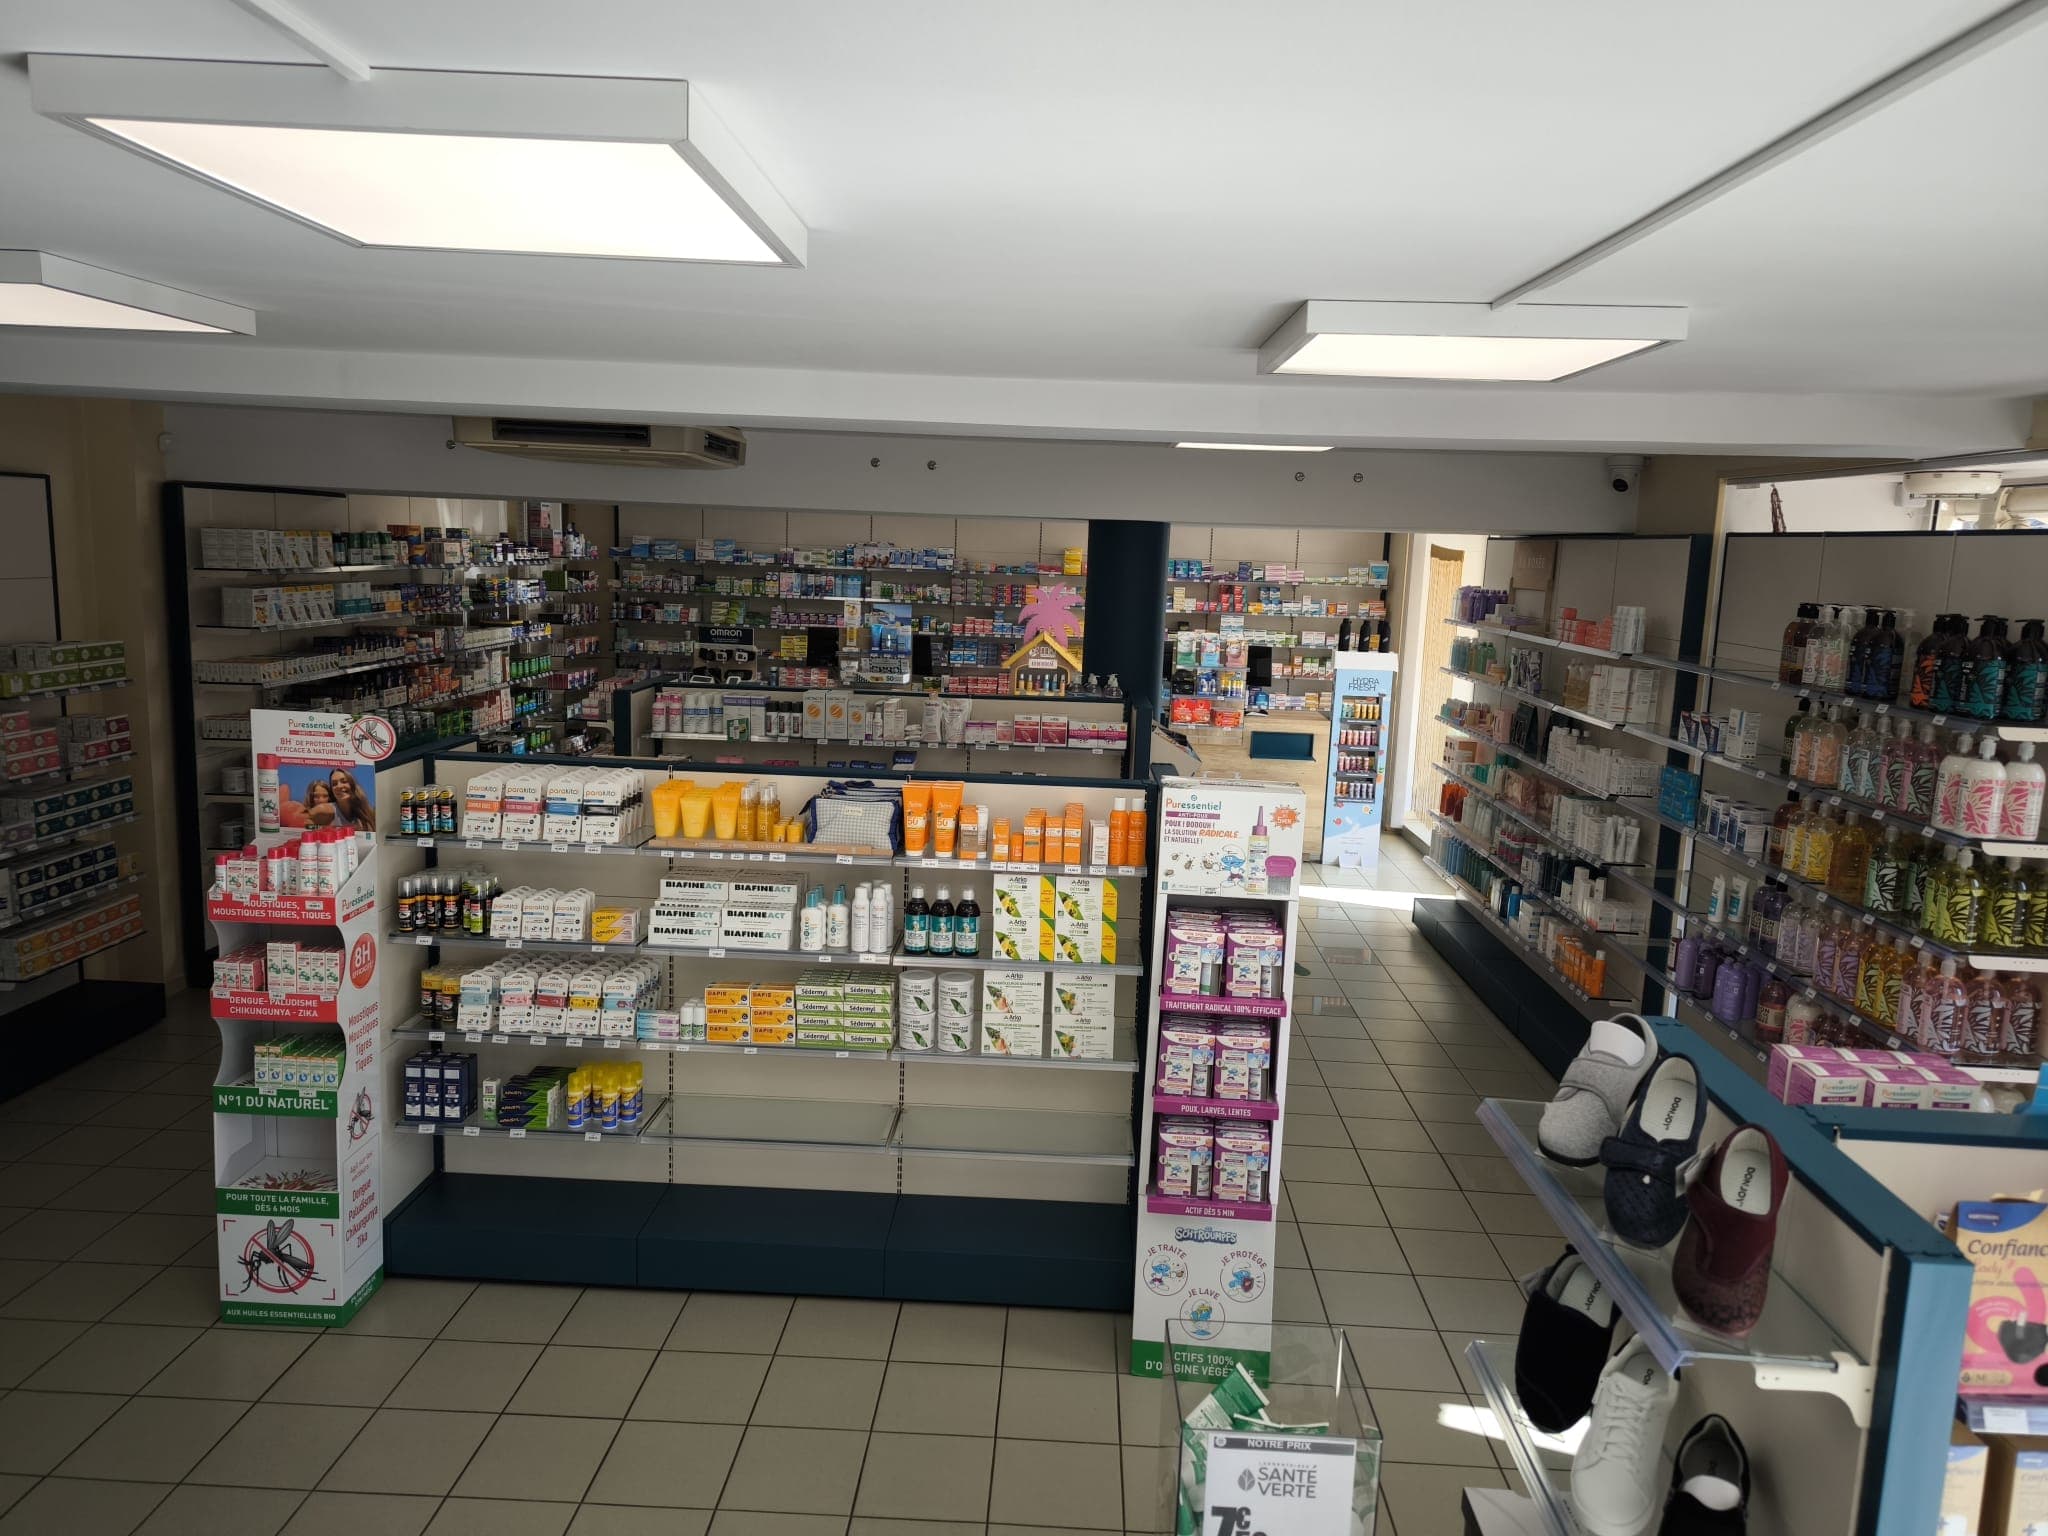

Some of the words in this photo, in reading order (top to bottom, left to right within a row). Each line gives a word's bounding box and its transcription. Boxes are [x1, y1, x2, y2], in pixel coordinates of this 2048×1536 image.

[1348, 683, 1376, 692] FRESH
[1352, 677, 1380, 686] HYDRA
[288, 718, 335, 730] Puressentiel
[275, 746, 308, 754] EFFICACE
[313, 748, 350, 756] NATURELLE
[305, 741, 345, 749] PROTECTION
[1166, 798, 1222, 811] Puressentiel
[1171, 836, 1200, 844] NATURELLE
[1199, 829, 1239, 839] RADICALE
[341, 885, 375, 911] Puressentiel
[244, 900, 300, 910] MOUSTIQUES,
[213, 908, 266, 918] MOUSTIQUES
[267, 910, 300, 920] TIGRES,
[302, 911, 332, 920] TIQUES
[354, 942, 371, 968] 8H
[801, 987, 828, 997] Sédermyl
[850, 985, 877, 995] Sédermyl
[270, 997, 318, 1008] PALUDISME
[802, 1002, 829, 1012] Sédermyl
[849, 1004, 877, 1013] Sédermyl
[1165, 1000, 1205, 1011] TRAITEMENT
[1205, 1003, 1232, 1013] RADICAL
[1233, 1005, 1252, 1014] 100%
[1253, 1006, 1281, 1016] EFFICACE
[230, 1006, 291, 1017] CHIKUNGUNYA
[298, 1008, 318, 1018] ZIKA
[348, 1003, 379, 1029] Moustiques
[802, 1017, 829, 1027] Sédermyl
[850, 1019, 877, 1029] Sédermyl
[348, 1020, 379, 1045] Moustiques
[803, 1031, 829, 1041] Sédermyl
[850, 1035, 877, 1045] Sédermyl
[356, 1038, 373, 1056] Tigres
[355, 1054, 374, 1073] Tiques
[218, 1094, 241, 1107] N°1
[246, 1096, 264, 1108] DU
[267, 1097, 329, 1110] NATUREL
[1181, 1105, 1200, 1115] POUX,
[1201, 1105, 1227, 1117] LARVES,
[1228, 1108, 1251, 1117] LENTES
[352, 1179, 371, 1202] Dengue
[226, 1192, 249, 1201] POUR
[250, 1193, 277, 1203] TOUTE
[278, 1195, 289, 1203] LA
[291, 1196, 329, 1206] FAMILLE,
[280, 1205, 300, 1213] MOIS
[348, 1192, 375, 1222] Paludisme
[1185, 1206, 1203, 1215] ACTIF
[1216, 1208, 1222, 1216] 5
[1222, 1209, 1235, 1218] MIN
[345, 1206, 378, 1242] Chikungunya
[357, 1231, 368, 1248] Zika
[1175, 1227, 1237, 1244] SCHTROUMPFS
[1147, 1246, 1156, 1257] JE
[1158, 1244, 1188, 1260] TRAITE
[1968, 1239, 2048, 1261] Confianc
[1221, 1256, 1230, 1266] JE
[1188, 1289, 1198, 1298] JE
[1199, 1287, 1221, 1300] LAVE
[226, 1308, 242, 1316] AUX
[243, 1309, 268, 1317] HUILES
[269, 1310, 322, 1320] ESSENTIELLES
[323, 1312, 336, 1320] BIO
[1173, 1351, 1204, 1363] CTIFS
[1207, 1353, 1234, 1366] 100%
[1145, 1360, 1199, 1376] D'OGINE
[1247, 1438, 1284, 1449] NOTRE
[1286, 1440, 1312, 1450] PRIX
[1257, 1464, 1318, 1485] SANTÉ
[1257, 1481, 1318, 1499] VERTE
